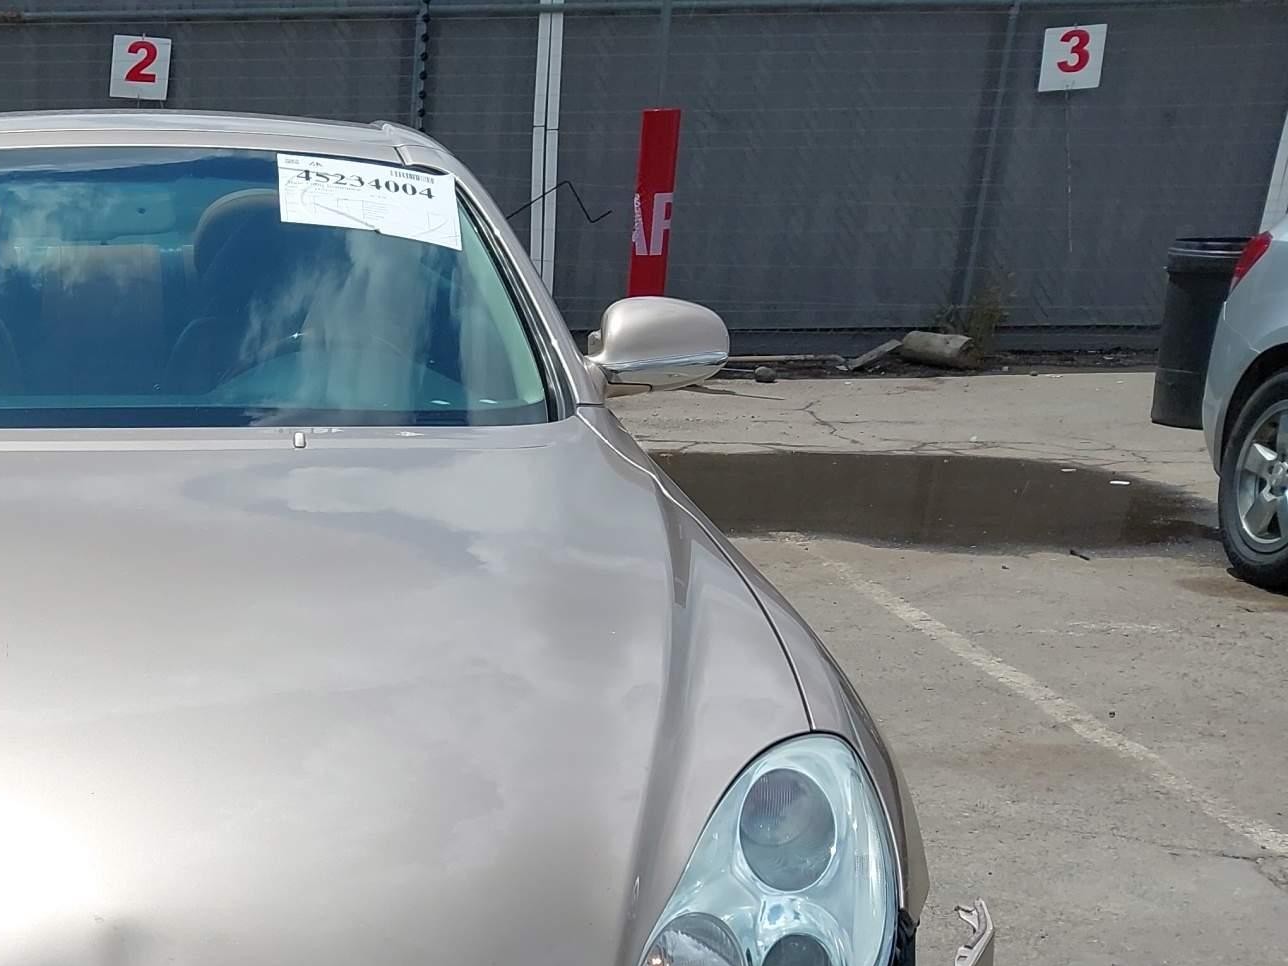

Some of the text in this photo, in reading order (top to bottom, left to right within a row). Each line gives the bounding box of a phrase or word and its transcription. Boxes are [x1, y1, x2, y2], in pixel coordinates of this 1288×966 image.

[124, 40, 158, 83] 2
[1057, 29, 1090, 73] 3
[296, 169, 436, 199] 45234004
